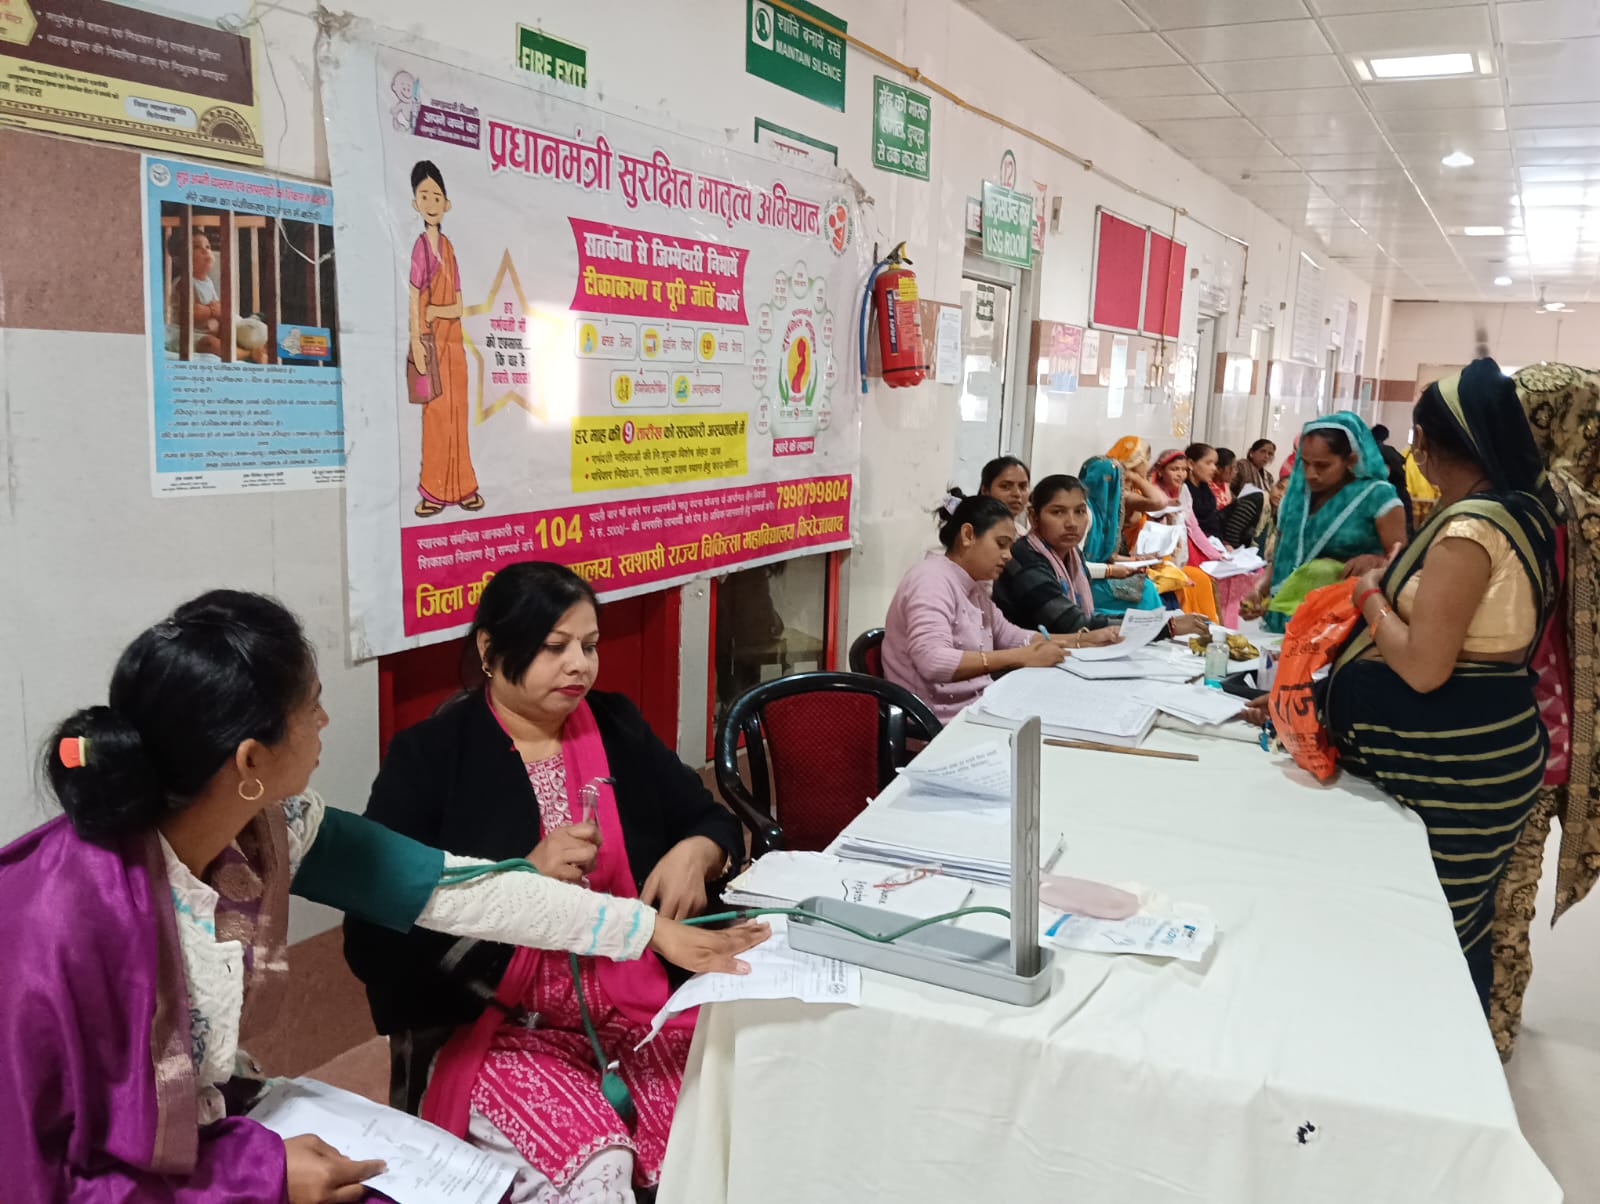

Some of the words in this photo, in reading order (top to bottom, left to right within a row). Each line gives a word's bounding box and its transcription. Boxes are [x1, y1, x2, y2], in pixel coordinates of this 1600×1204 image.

[522, 46, 553, 78] FIRE
[555, 57, 584, 88] EXIT
[812, 57, 841, 82] SILENCE
[877, 138, 885, 160] से
[901, 150, 914, 169] कर
[488, 120, 613, 190] प्रधानमंत्री
[618, 150, 693, 209] सुरक्षित
[698, 176, 751, 228] मातृत्व
[757, 183, 820, 235] अभियान
[583, 231, 633, 262] सतर्कता
[636, 235, 648, 265] से
[651, 237, 704, 272] जिम्मेदारी
[987, 226, 1003, 254] USG
[1005, 231, 1028, 259] ROOM
[583, 265, 648, 301] टीकाकरण
[652, 280, 661, 302] व
[666, 278, 686, 312] पूरी
[575, 428, 589, 444] हर
[609, 425, 620, 442] की
[626, 424, 633, 442] 9
[664, 423, 674, 438] को
[676, 421, 705, 439] सरकारी
[777, 480, 848, 510] 7998799804
[481, 523, 512, 540] जानकारी
[535, 514, 583, 549] 104
[416, 583, 463, 618] जिला
[618, 543, 664, 577] स्वशासी
[668, 541, 699, 566] राज्य
[701, 532, 741, 560] चिकित्सा
[797, 515, 844, 538] फिरोजाबाद
[417, 554, 454, 570] शिकायत
[455, 547, 483, 564] निवारण
[484, 545, 495, 562] हेतु
